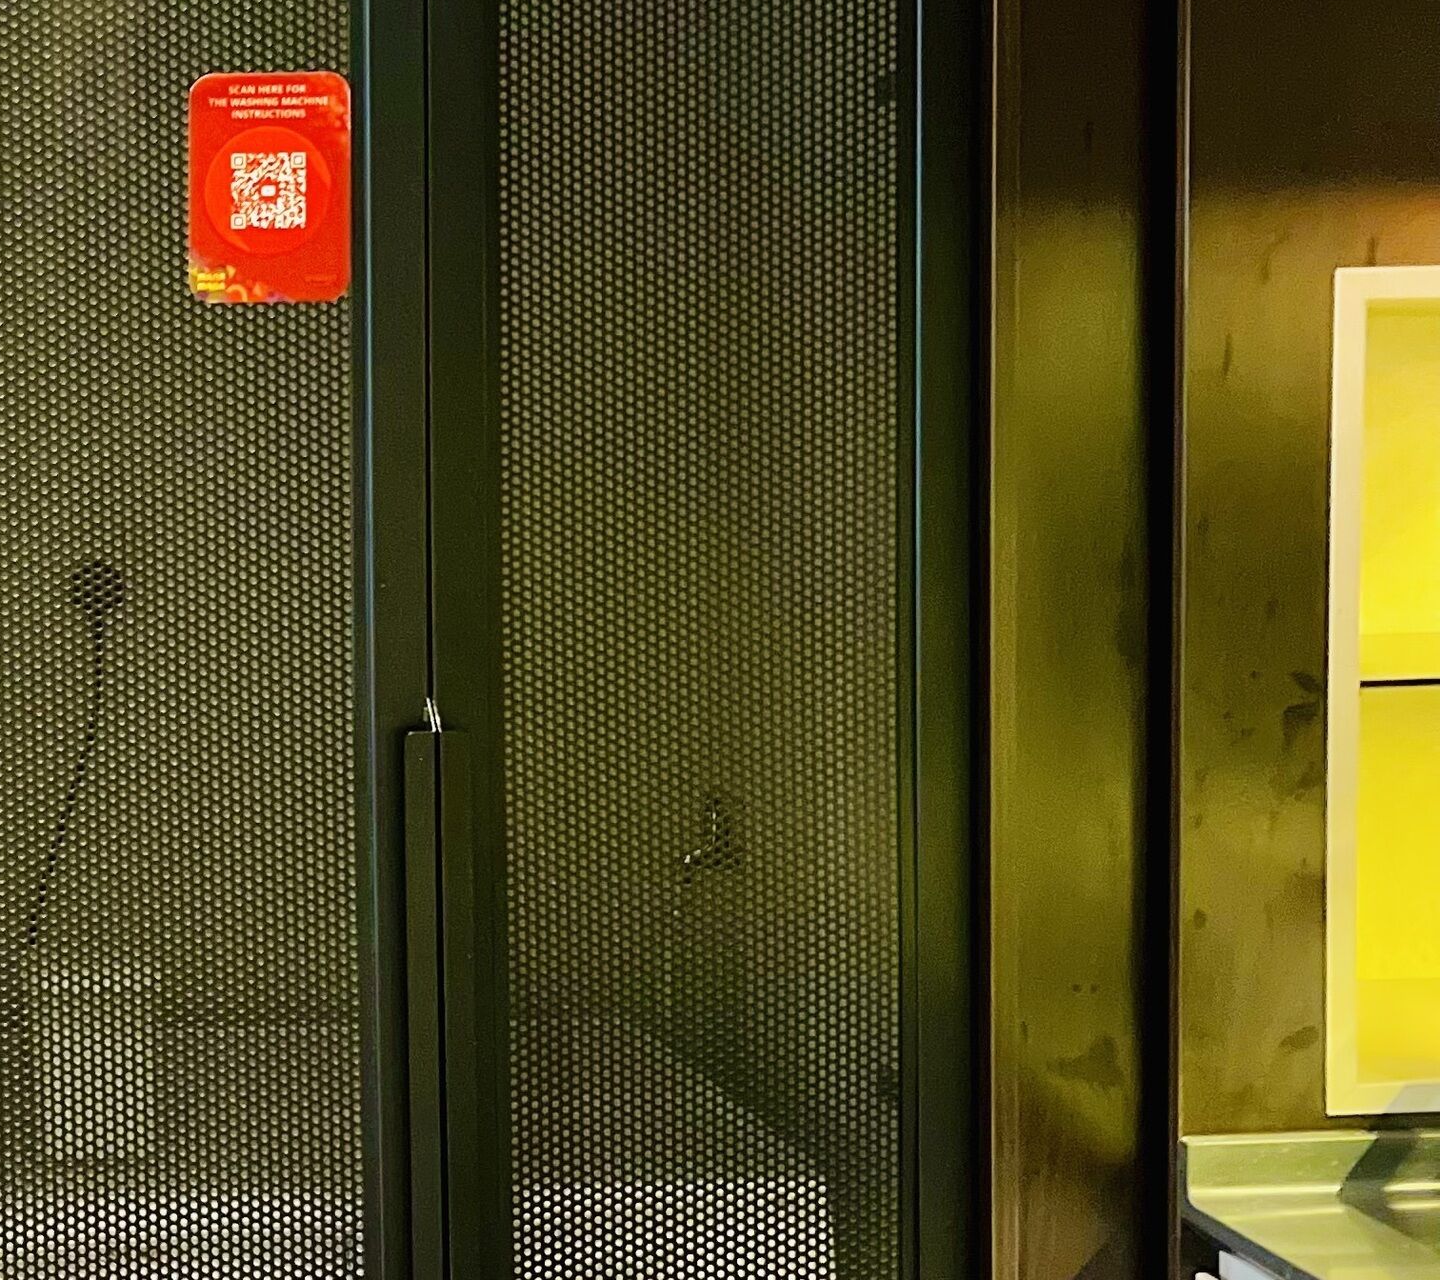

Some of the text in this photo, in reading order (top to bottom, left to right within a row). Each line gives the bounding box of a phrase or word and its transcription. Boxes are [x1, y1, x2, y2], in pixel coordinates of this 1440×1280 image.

[228, 83, 307, 95] SCAN HERE FOR
[208, 95, 329, 108] THE WASHING MACHINE
[231, 108, 307, 119] INSTRUCTIONS
